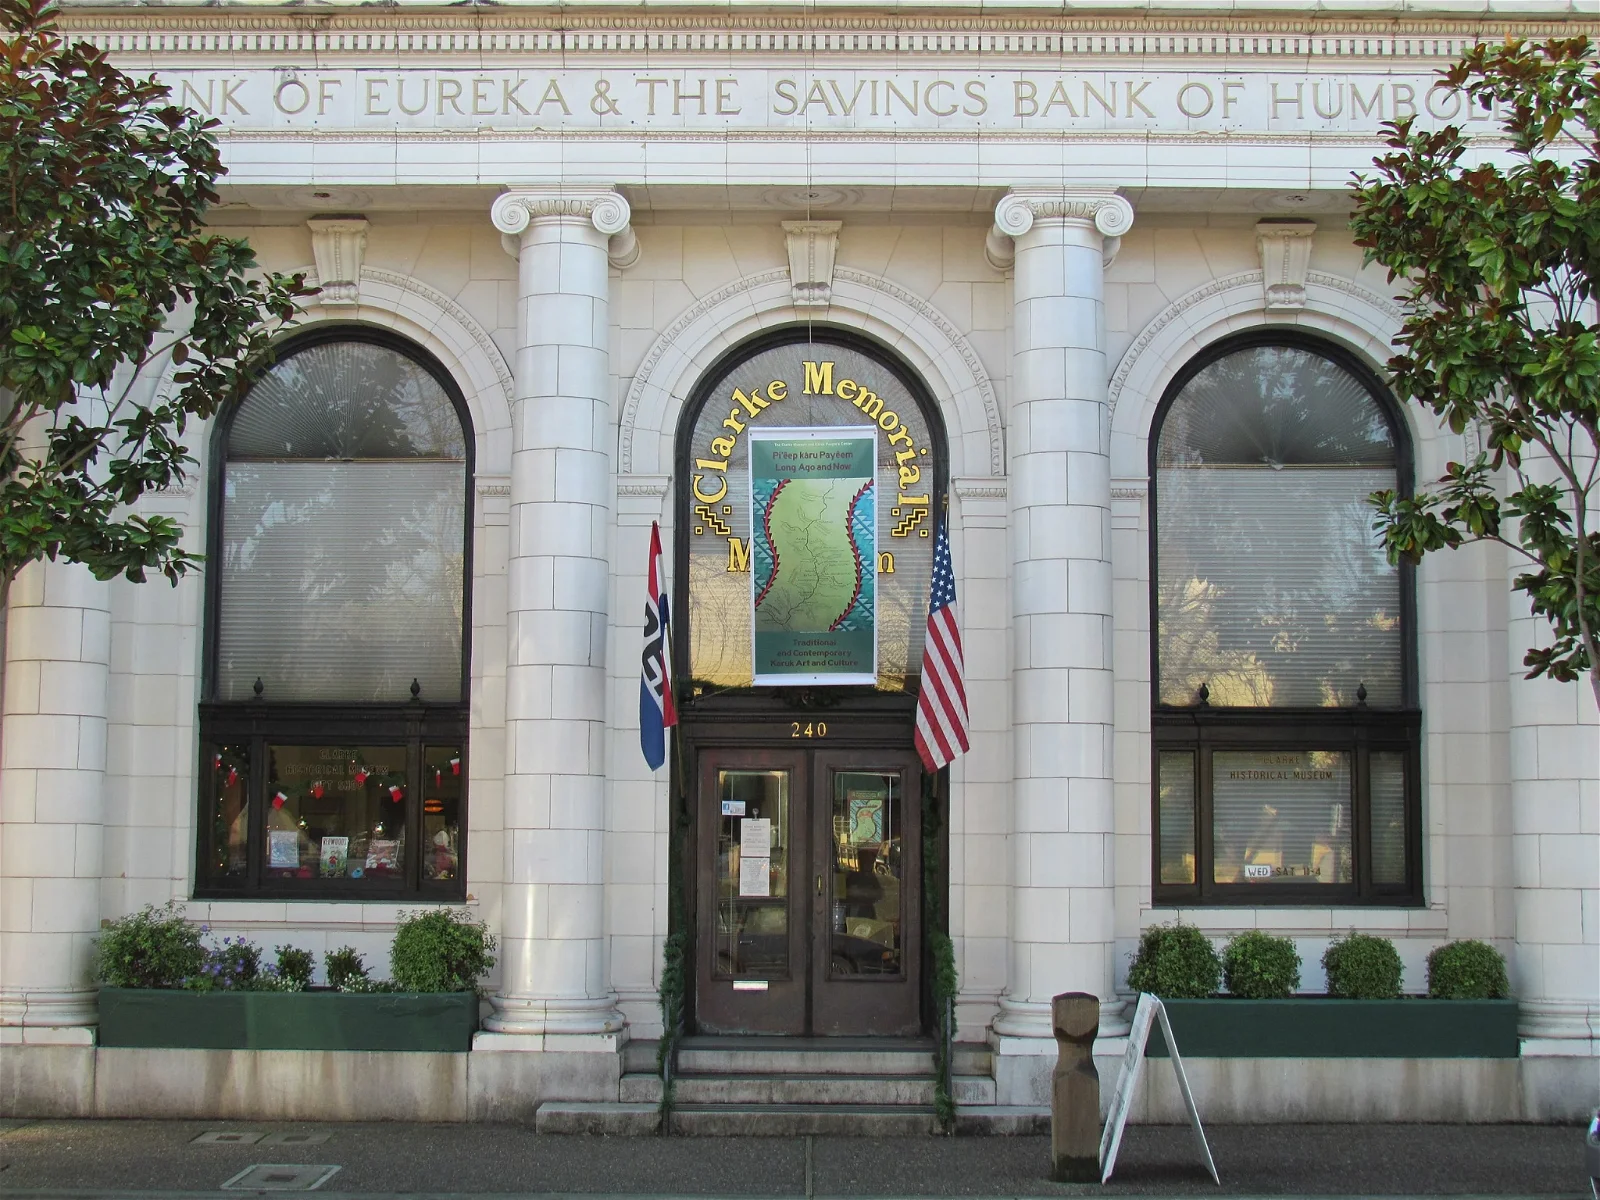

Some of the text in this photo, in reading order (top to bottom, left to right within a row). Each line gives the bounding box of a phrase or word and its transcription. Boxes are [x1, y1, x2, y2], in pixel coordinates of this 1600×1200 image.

[132, 79, 250, 115] NK
[273, 79, 342, 115] OF
[365, 78, 572, 116] EUREKA
[590, 79, 621, 116] &
[635, 79, 743, 116] THE
[773, 79, 989, 117] SAVINGS
[1013, 80, 1157, 119] BANK
[1176, 82, 1247, 119] OF
[692, 361, 930, 506] Clarke Memorial
[775, 464, 796, 473] Long
[817, 463, 832, 471] and
[833, 462, 851, 470] Now
[793, 639, 837, 647] Traditional
[776, 649, 852, 658] and Contemporary
[811, 659, 826, 667] and
[827, 659, 859, 667] Culture
[791, 722, 827, 738] 240
[1230, 770, 1333, 780] HISTORICAL MUSEUM
